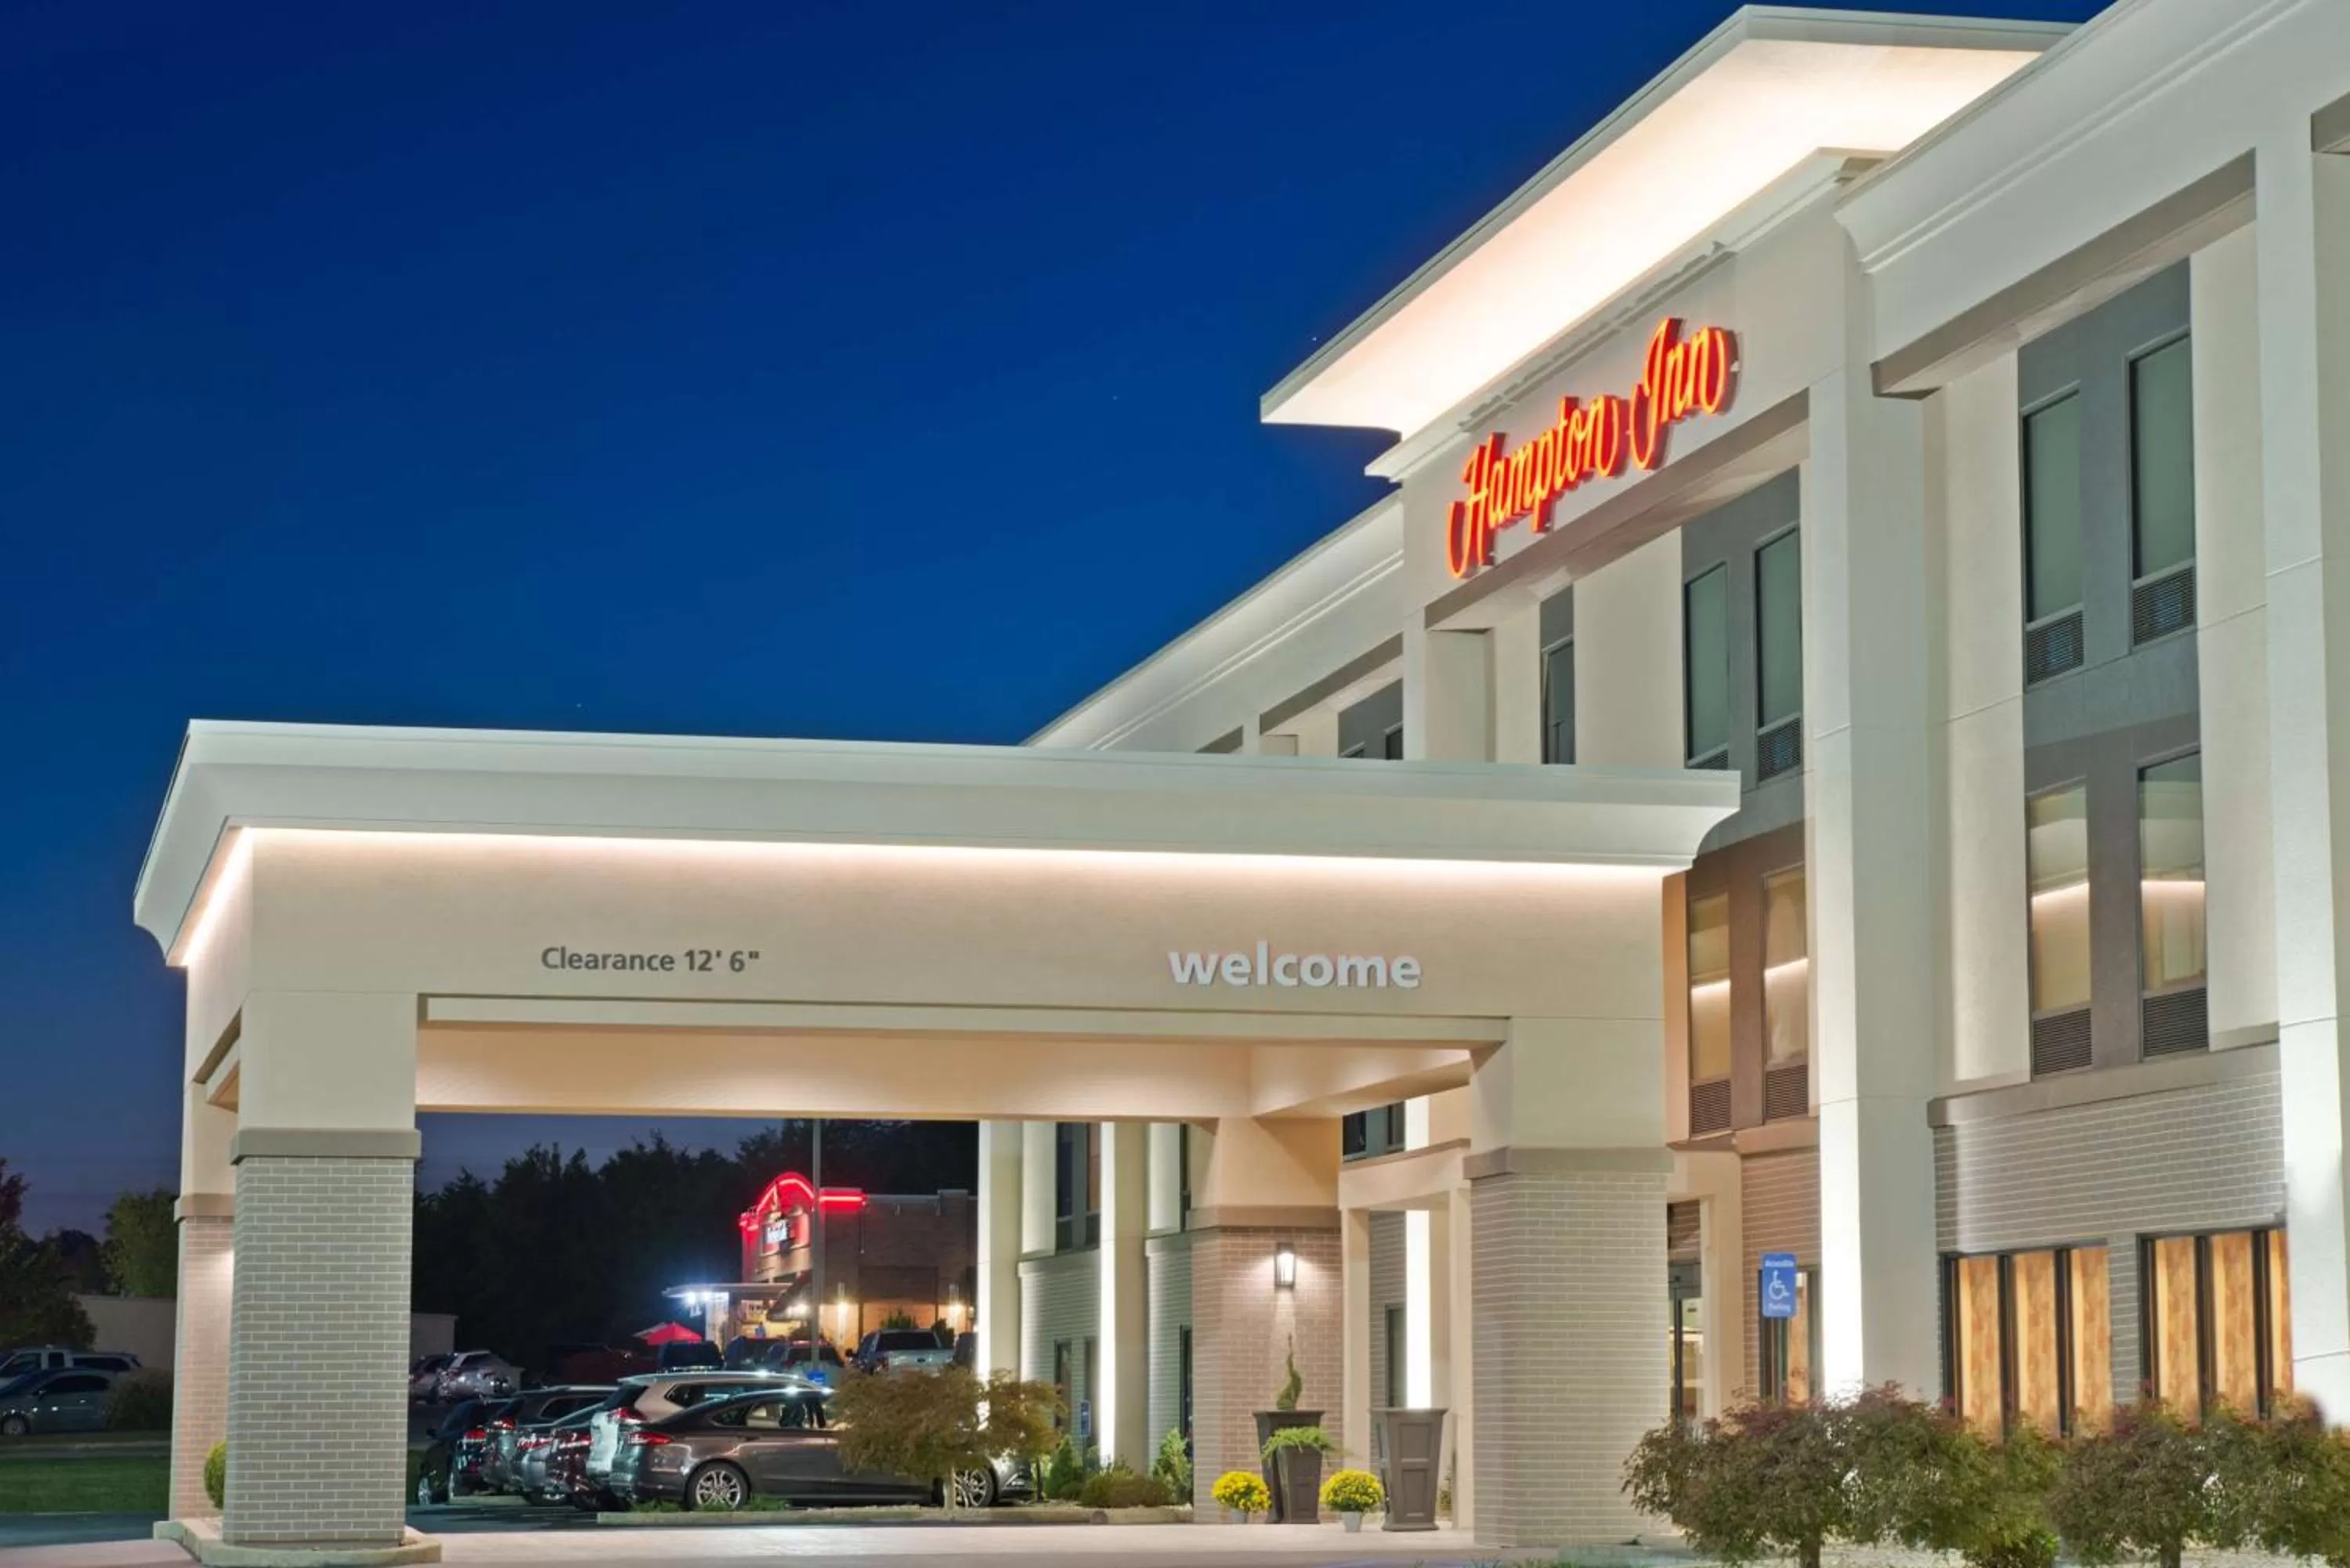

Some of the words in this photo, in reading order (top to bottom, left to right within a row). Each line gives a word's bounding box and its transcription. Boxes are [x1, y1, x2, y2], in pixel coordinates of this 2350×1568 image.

[1448, 396, 1629, 579] Hampton
[1629, 318, 1738, 470] Inn
[541, 946, 675, 971] Clearance
[684, 949, 722, 971] 12'
[729, 950, 760, 972] 6"
[1168, 940, 1422, 988] welcome
